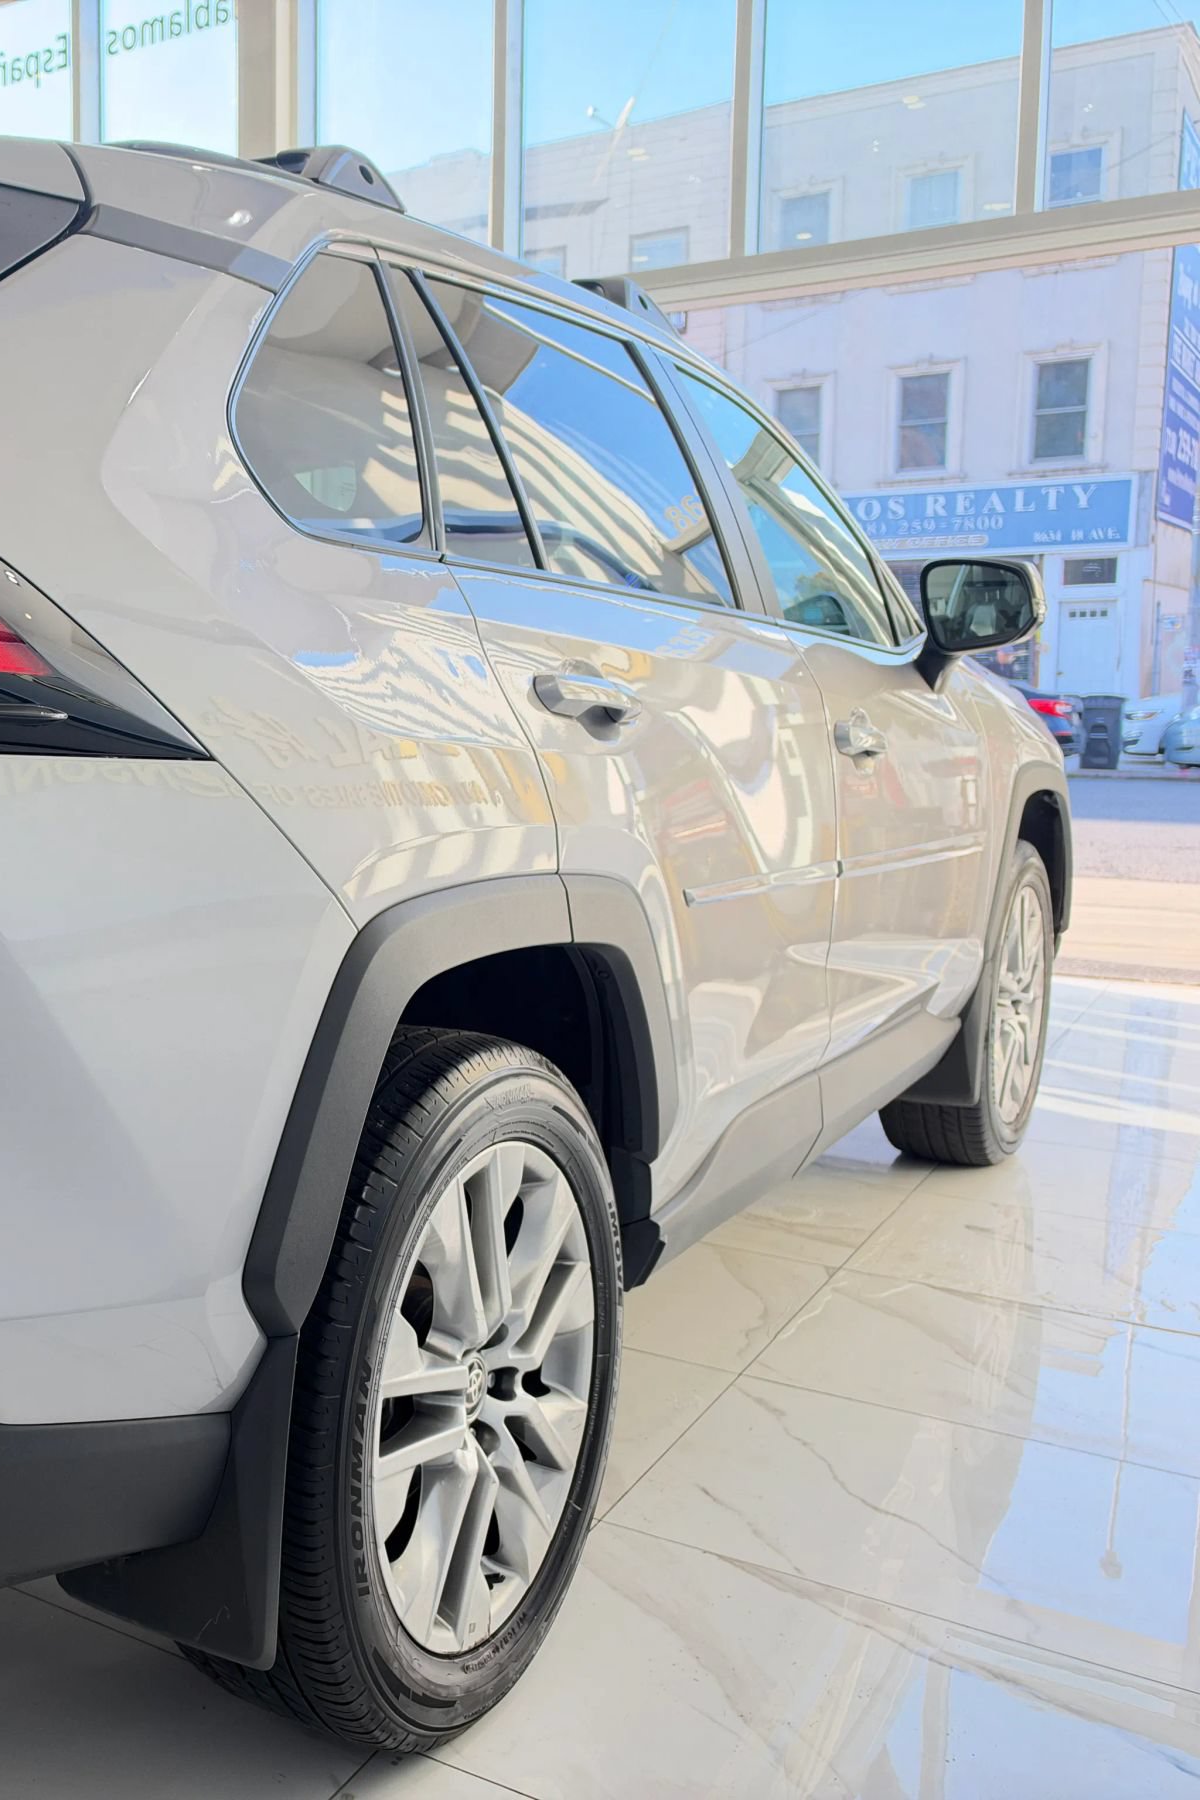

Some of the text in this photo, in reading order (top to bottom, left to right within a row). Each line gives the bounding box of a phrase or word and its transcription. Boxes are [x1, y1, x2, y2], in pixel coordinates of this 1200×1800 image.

[845, 484, 1098, 521] OS REALTY
[351, 1357, 374, 1598] IRONMAN
